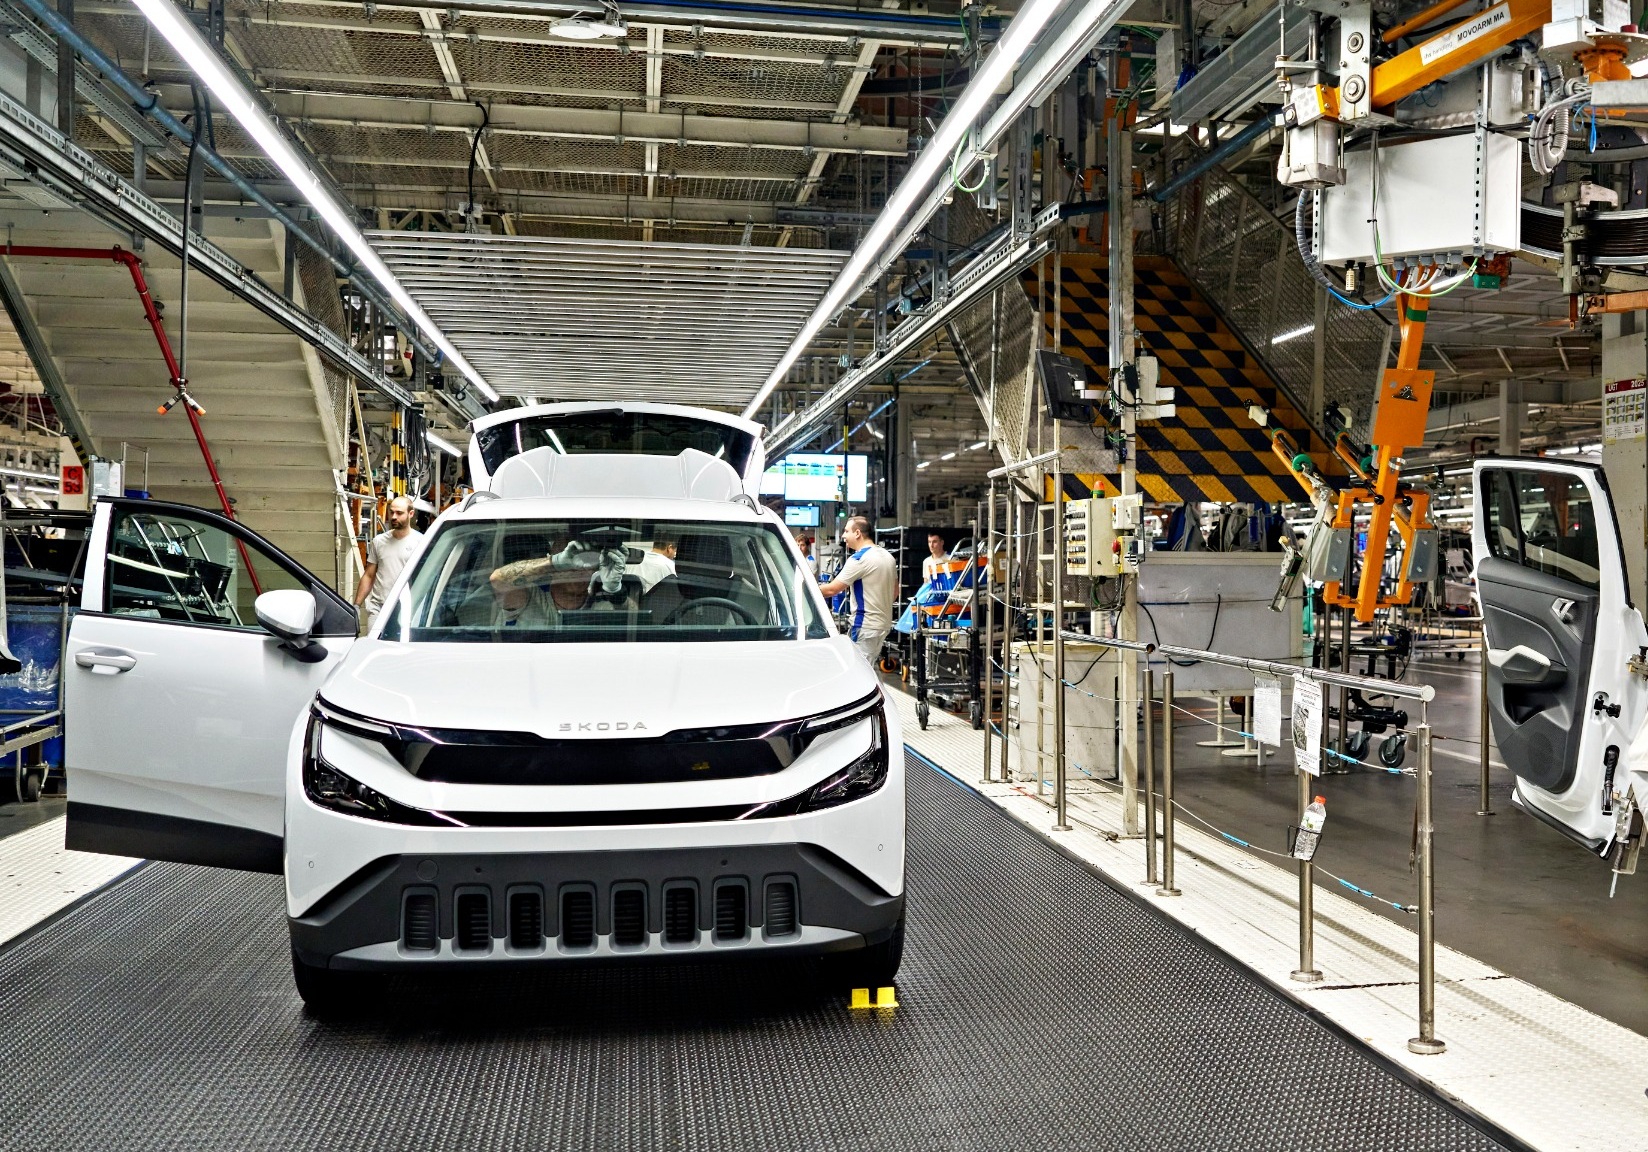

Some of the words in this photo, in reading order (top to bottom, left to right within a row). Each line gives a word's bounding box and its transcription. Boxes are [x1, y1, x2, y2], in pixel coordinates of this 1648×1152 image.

[1457, 18, 1492, 41] MOVOARM
[1493, 11, 1505, 23] MA
[1608, 383, 1618, 391] UGT
[1631, 380, 1645, 388] 2025
[65, 481, 81, 493] 53
